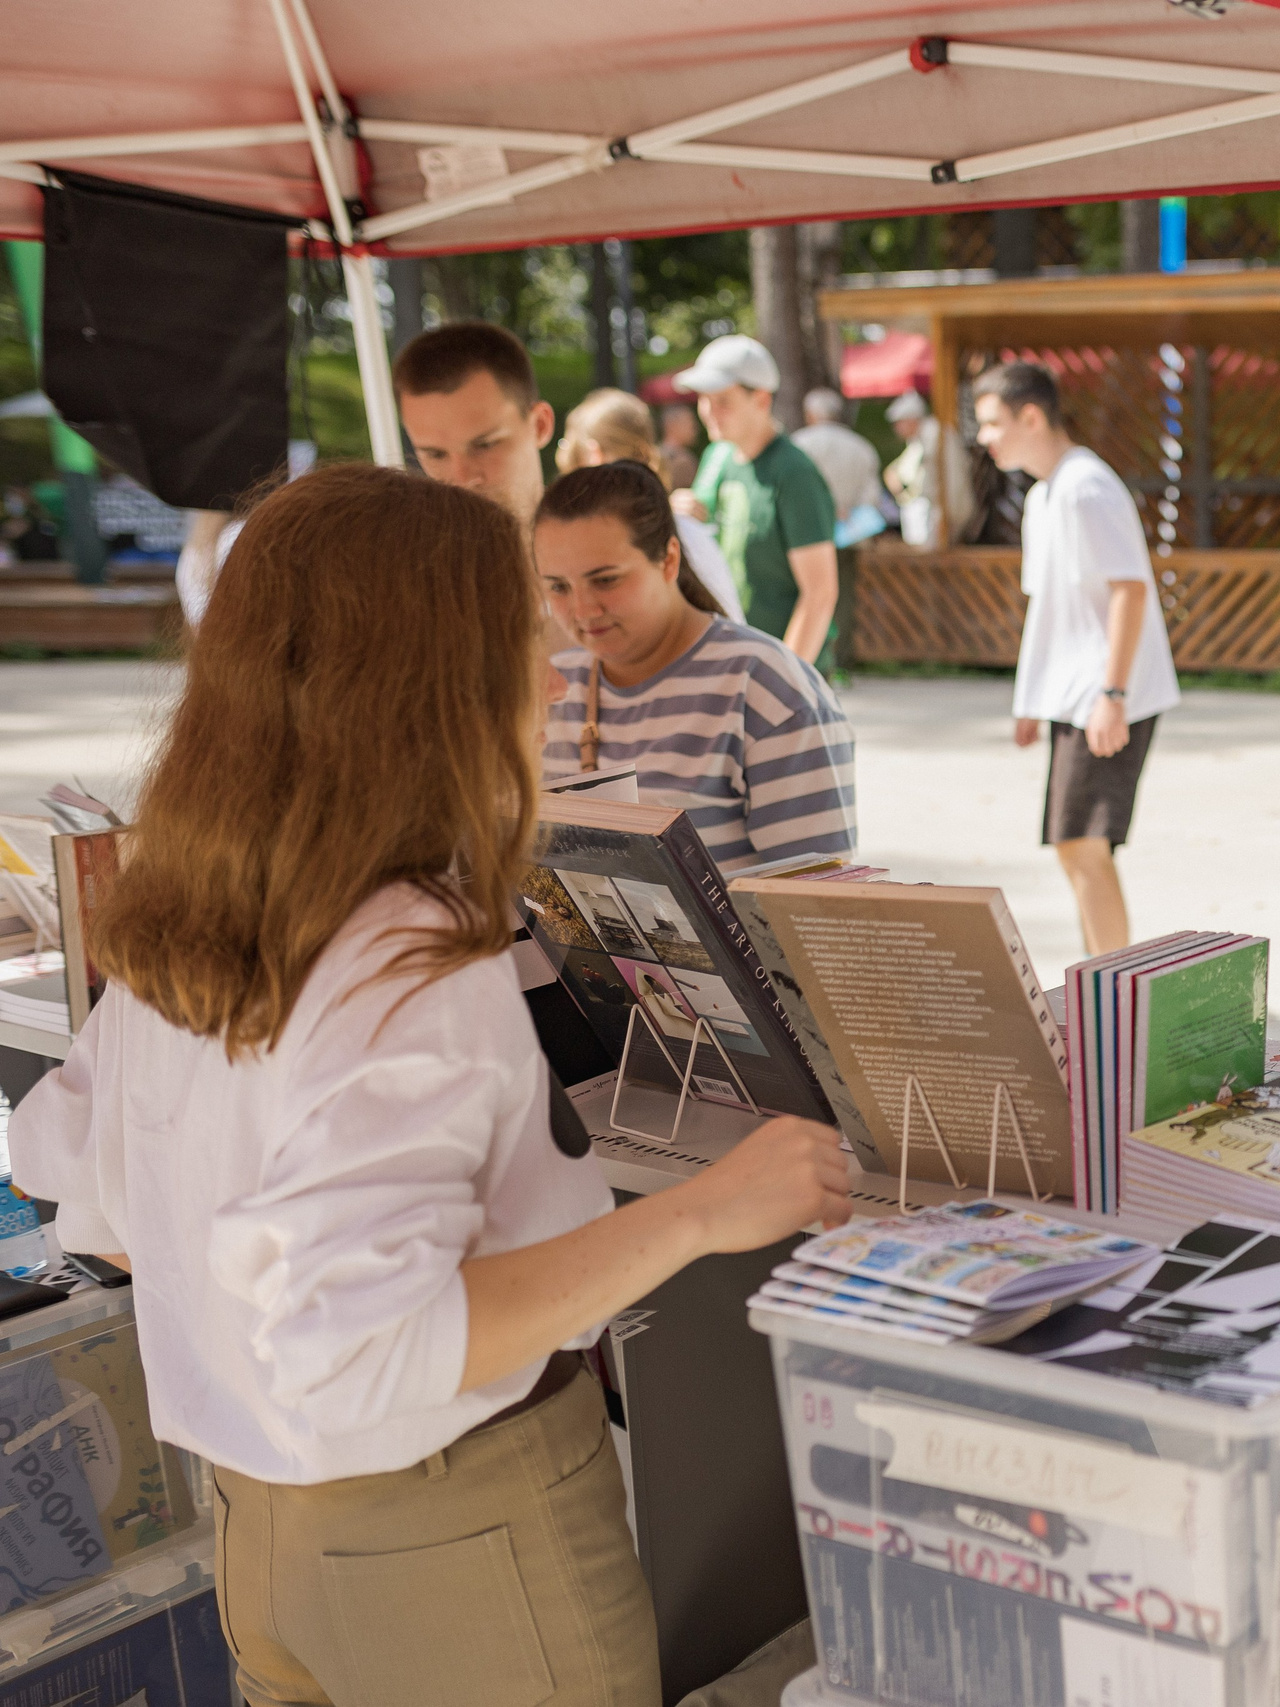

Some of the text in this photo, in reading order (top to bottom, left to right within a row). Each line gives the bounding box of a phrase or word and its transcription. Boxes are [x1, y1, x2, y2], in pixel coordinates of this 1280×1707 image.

[699, 871, 728, 914] THE
[727, 921, 755, 958] ART
[754, 966, 774, 990] OF
[0, 1417, 103, 1568] орафия
[75, 1424, 100, 1464] ДНК
